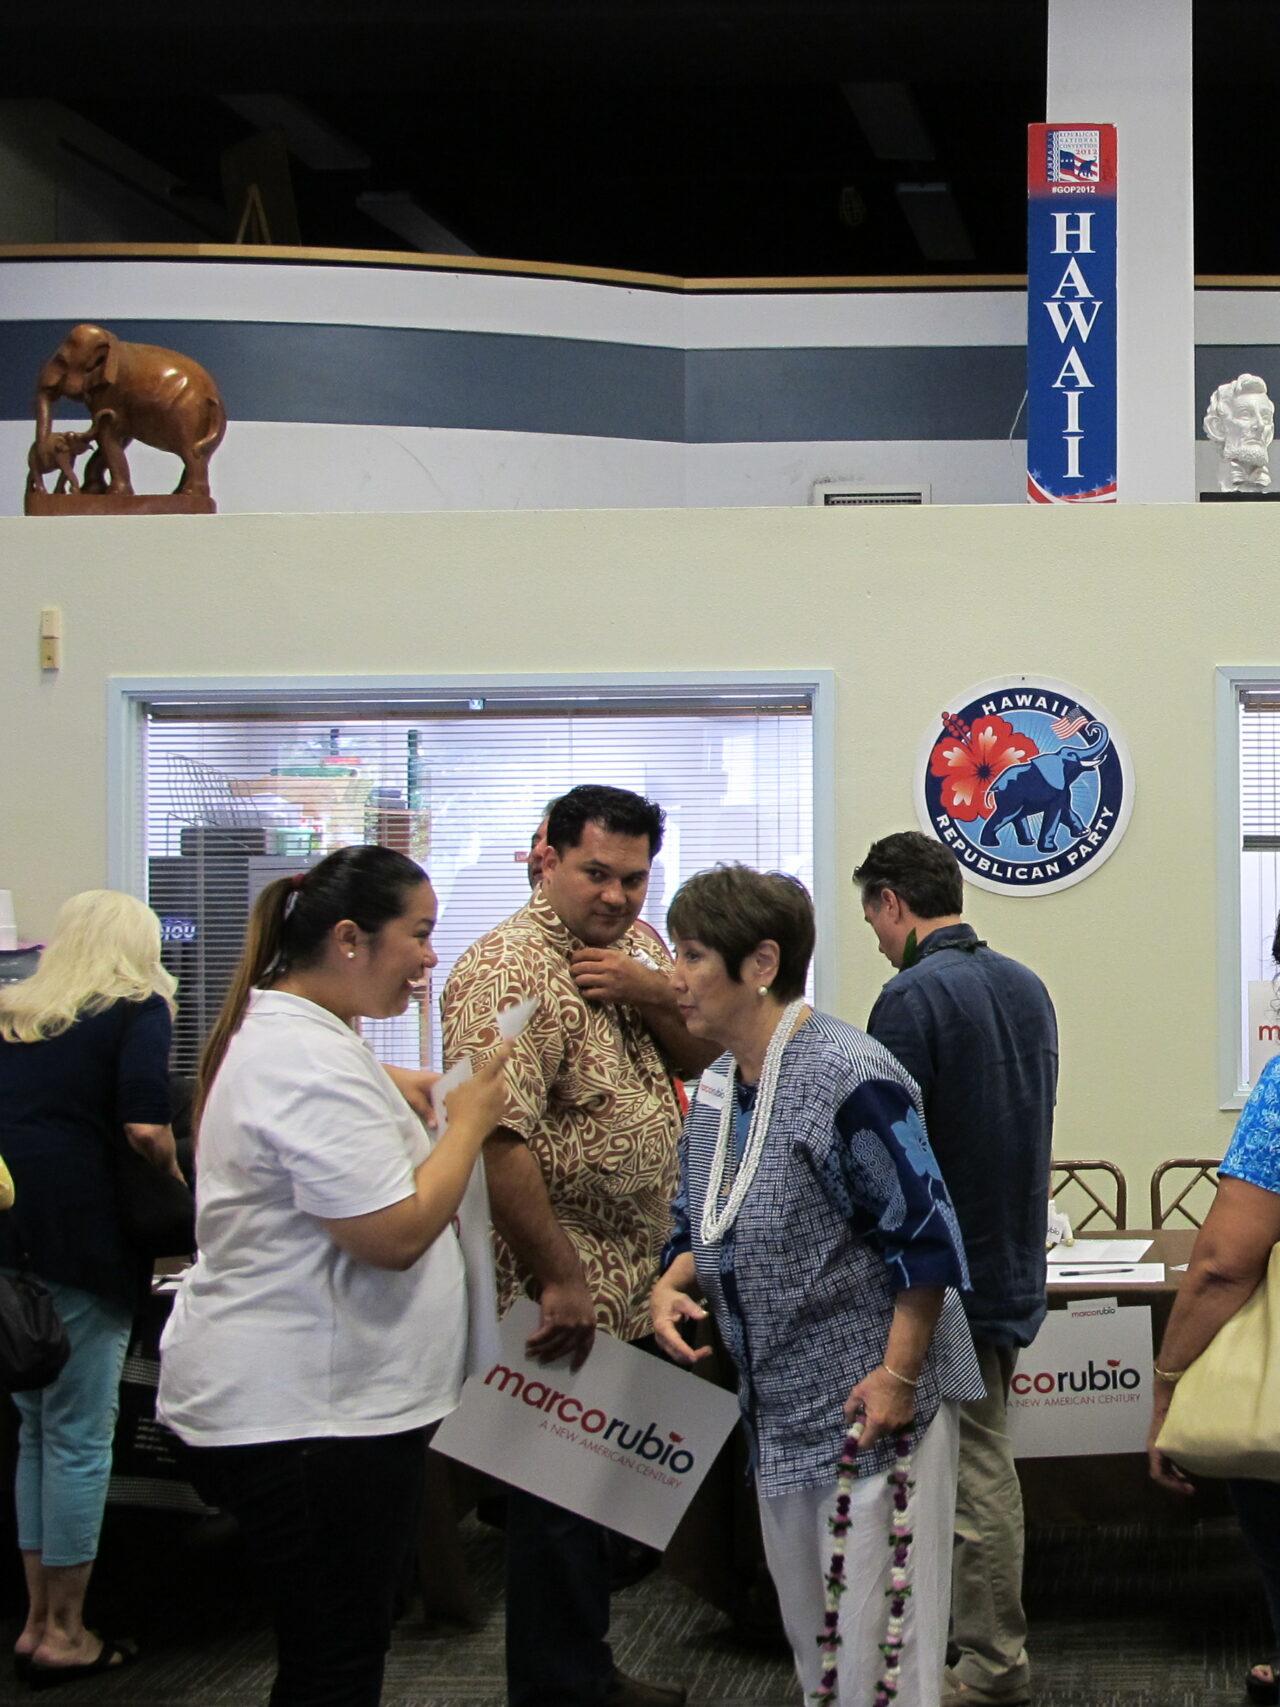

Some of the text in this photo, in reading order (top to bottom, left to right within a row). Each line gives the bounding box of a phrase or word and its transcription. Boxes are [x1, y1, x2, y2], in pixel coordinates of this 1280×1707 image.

[1052, 185, 1095, 193] #GOP2012
[1043, 212, 1103, 478] HAWAII
[982, 695, 1068, 716] HAWAII
[936, 805, 1114, 879] REPUBLICAN PARTY
[1071, 1306, 1116, 1318] marcorubio
[484, 1364, 695, 1474] marcorubio
[1016, 1399, 1041, 1408] NEW
[1044, 1395, 1095, 1406] AMERICAN
[1099, 1393, 1141, 1404] CENTURY
[539, 1420, 683, 1489] A NEW AMERICAN CENTURY
